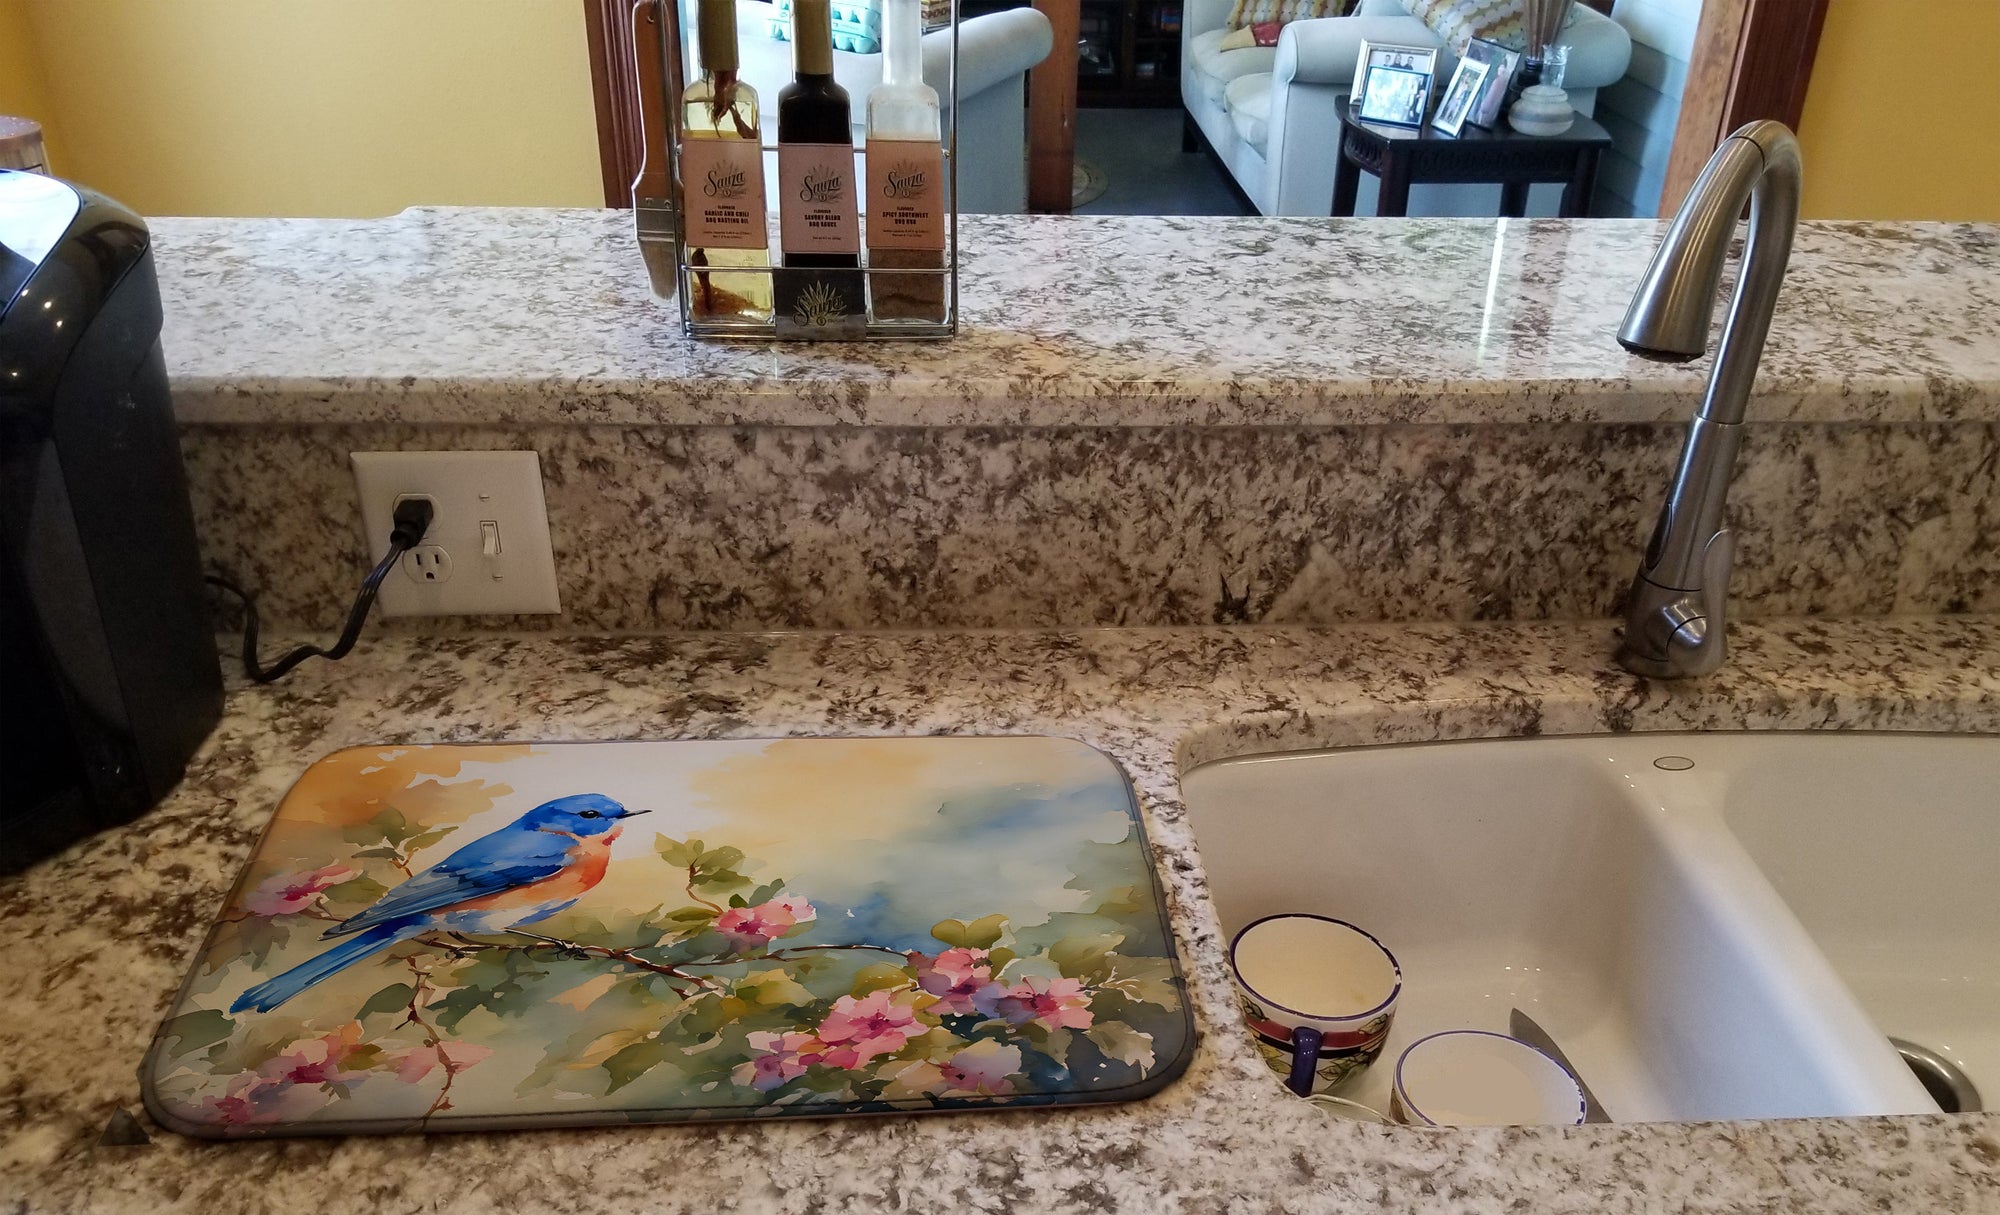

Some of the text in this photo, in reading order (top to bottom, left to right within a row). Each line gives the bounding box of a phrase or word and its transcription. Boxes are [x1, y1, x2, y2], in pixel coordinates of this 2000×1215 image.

[703, 169, 746, 197] Sauza
[799, 175, 842, 203] Sauza
[883, 171, 926, 198] Sauza
[793, 296, 845, 327] Sauza
